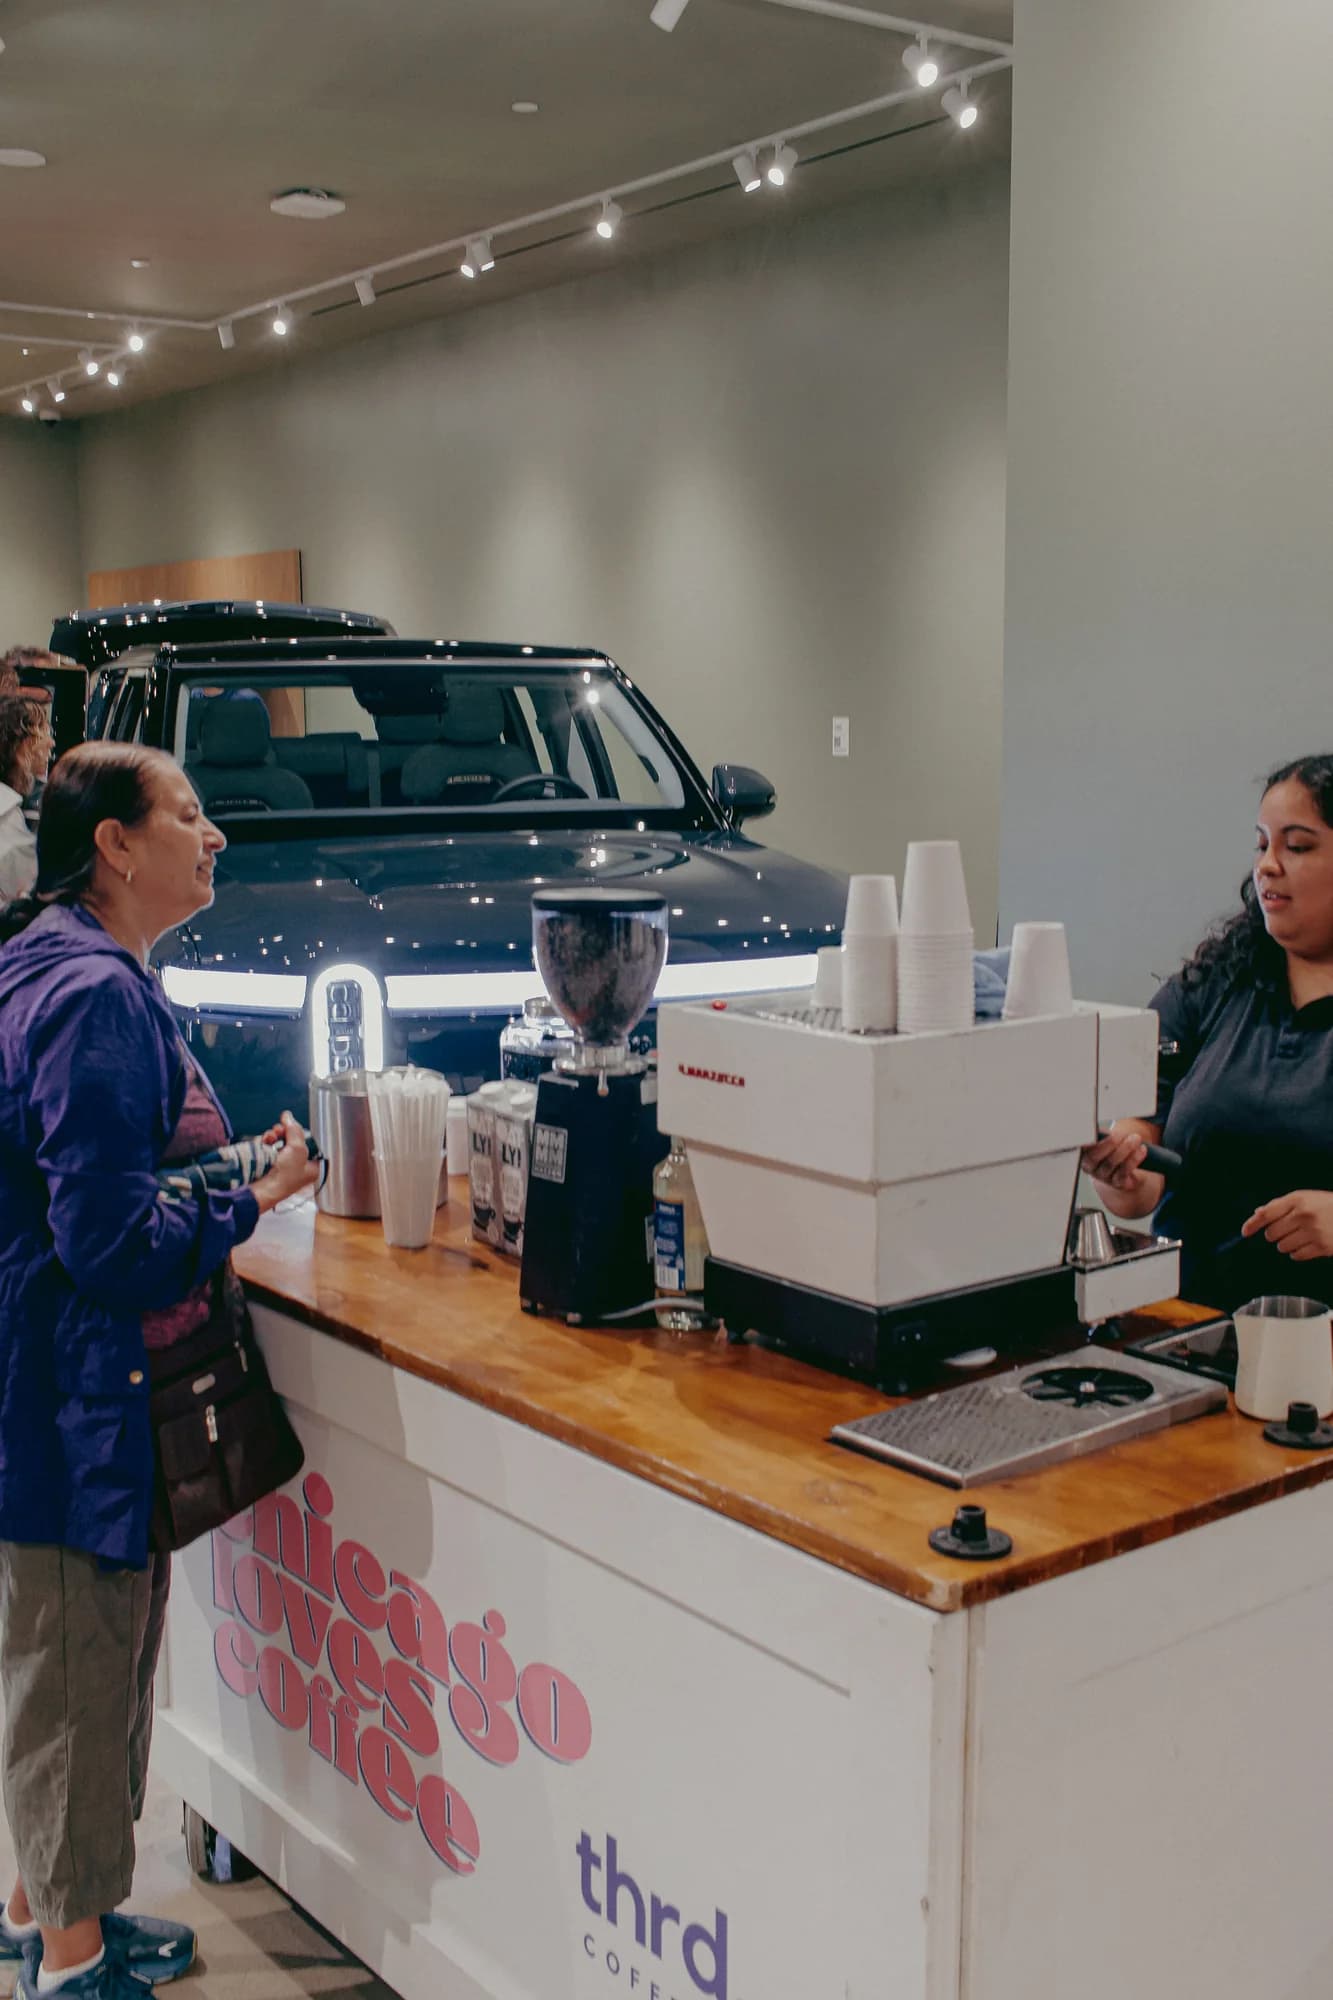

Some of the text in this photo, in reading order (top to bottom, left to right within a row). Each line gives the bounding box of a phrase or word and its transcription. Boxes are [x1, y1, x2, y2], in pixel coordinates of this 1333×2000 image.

[211, 1527, 440, 1757] loves
[219, 1471, 592, 1767] hicago
[214, 1620, 481, 1877] coffee
[576, 1830, 728, 2000] thrd
[584, 1934, 677, 2000] COFF
